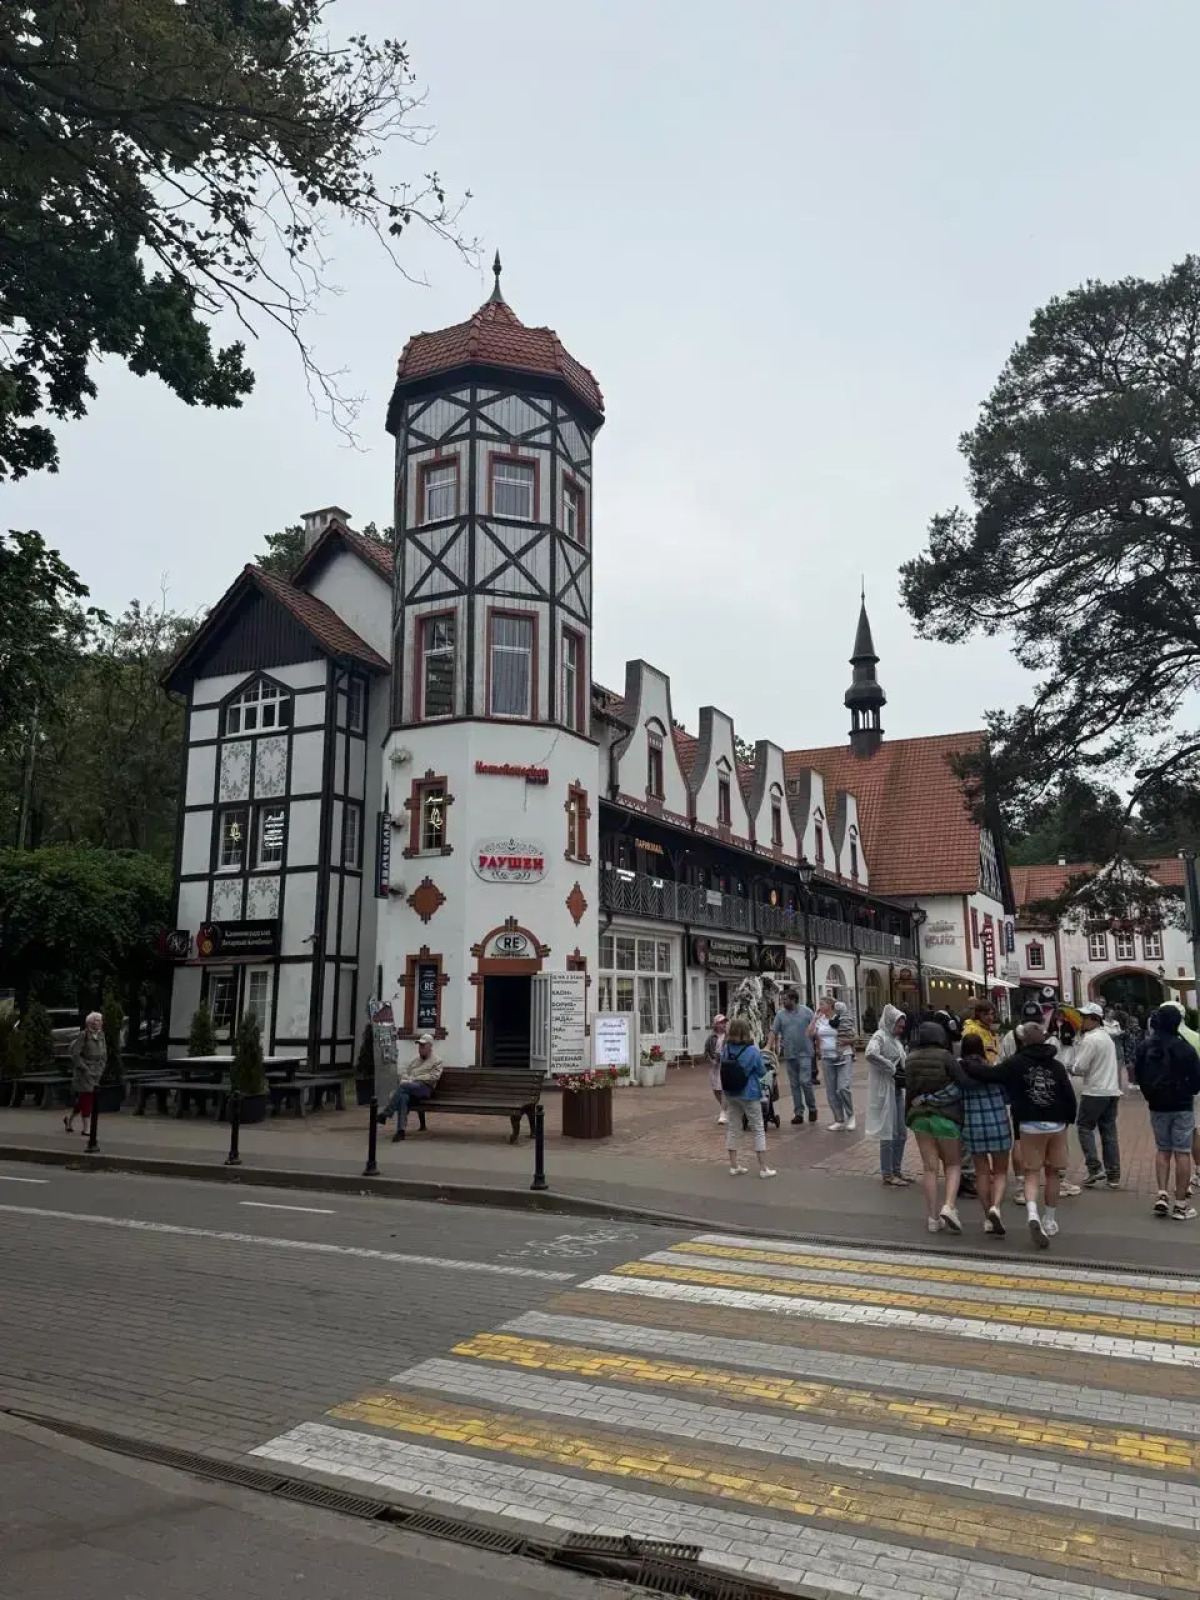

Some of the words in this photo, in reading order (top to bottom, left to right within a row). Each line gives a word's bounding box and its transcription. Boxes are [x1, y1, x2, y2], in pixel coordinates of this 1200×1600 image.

[479, 855, 544, 870] РАУШЕН
[503, 936, 521, 949] RE
[424, 982, 435, 990] RE
